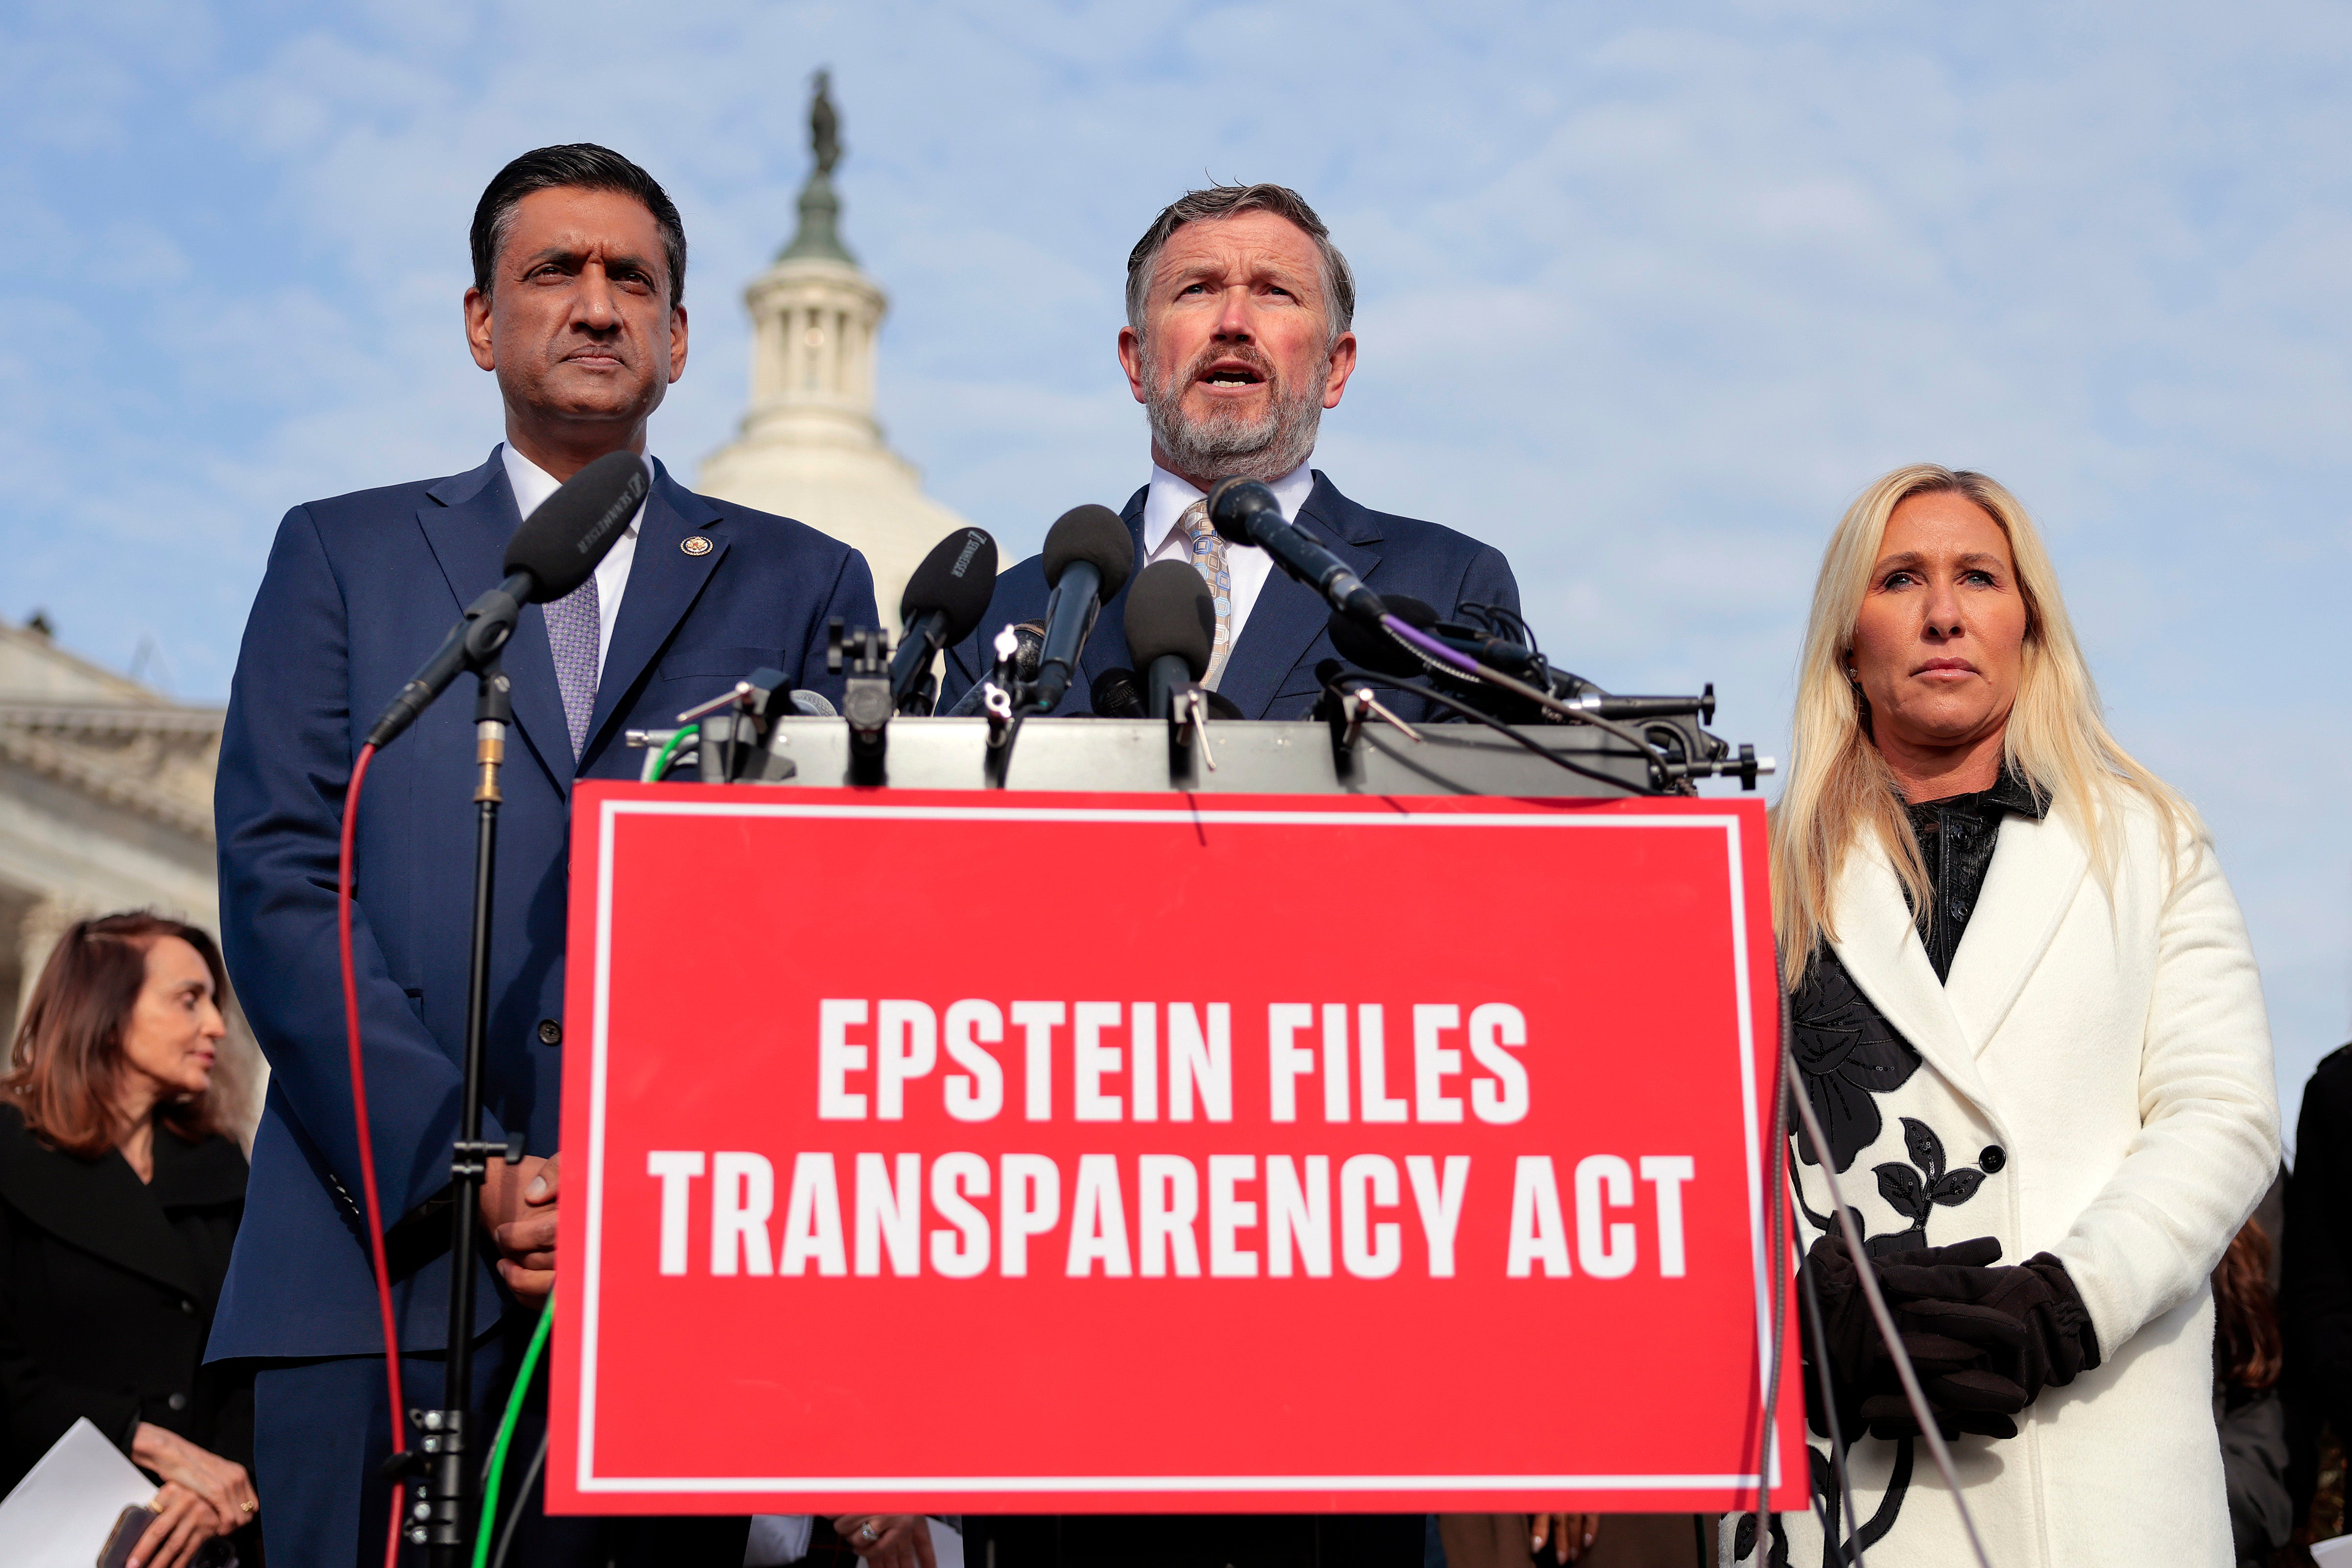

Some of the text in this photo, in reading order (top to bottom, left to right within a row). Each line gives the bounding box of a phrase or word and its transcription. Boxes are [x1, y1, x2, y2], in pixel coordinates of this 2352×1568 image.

[950, 539, 980, 578] SENNHEISER
[818, 998, 1529, 1124] EPSTEIN FILES
[647, 1151, 1695, 1279] TRANSPARENCY ACT
